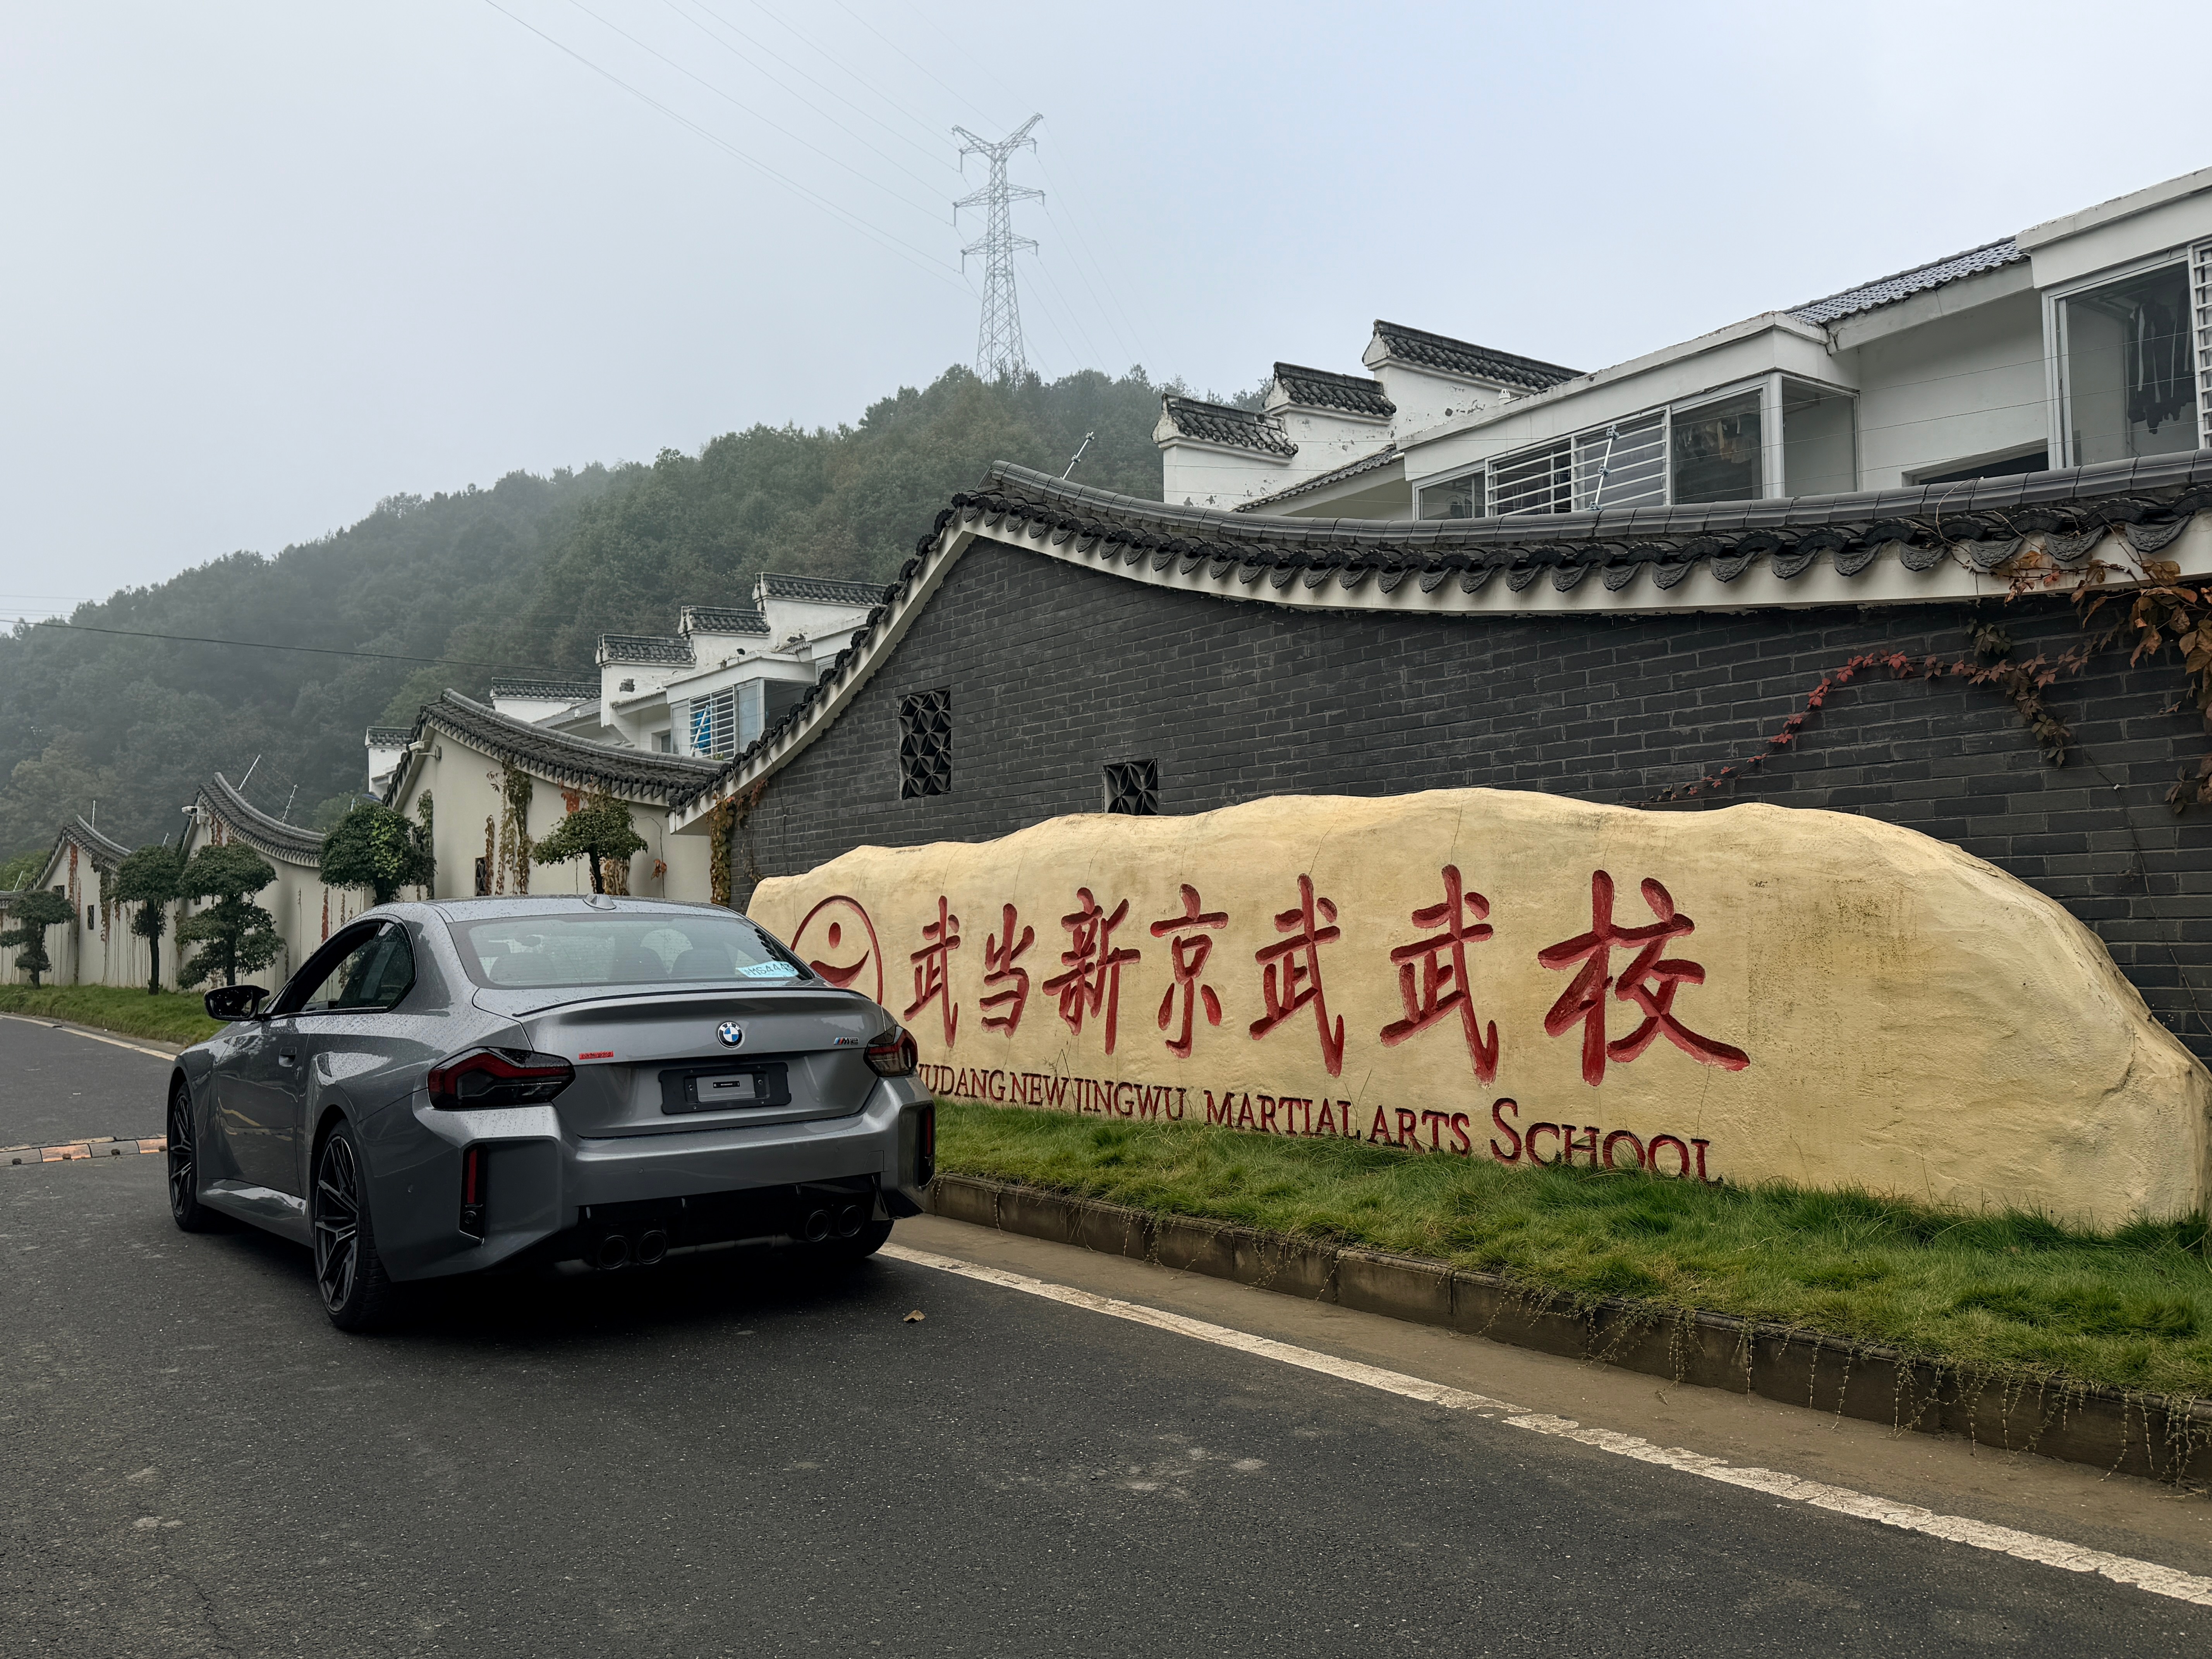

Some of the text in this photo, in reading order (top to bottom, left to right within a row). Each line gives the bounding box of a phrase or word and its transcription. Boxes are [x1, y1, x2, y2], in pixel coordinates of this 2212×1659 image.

[903, 865, 1750, 1087] 武当新京武武校
[720, 1022, 740, 1031] BMW
[841, 1037, 859, 1045] M2
[919, 1063, 1006, 1102] UDANG
[1009, 1071, 1069, 1107] NEW
[1203, 1090, 1360, 1140] MARTIAL
[1366, 1105, 1472, 1157] ARTS
